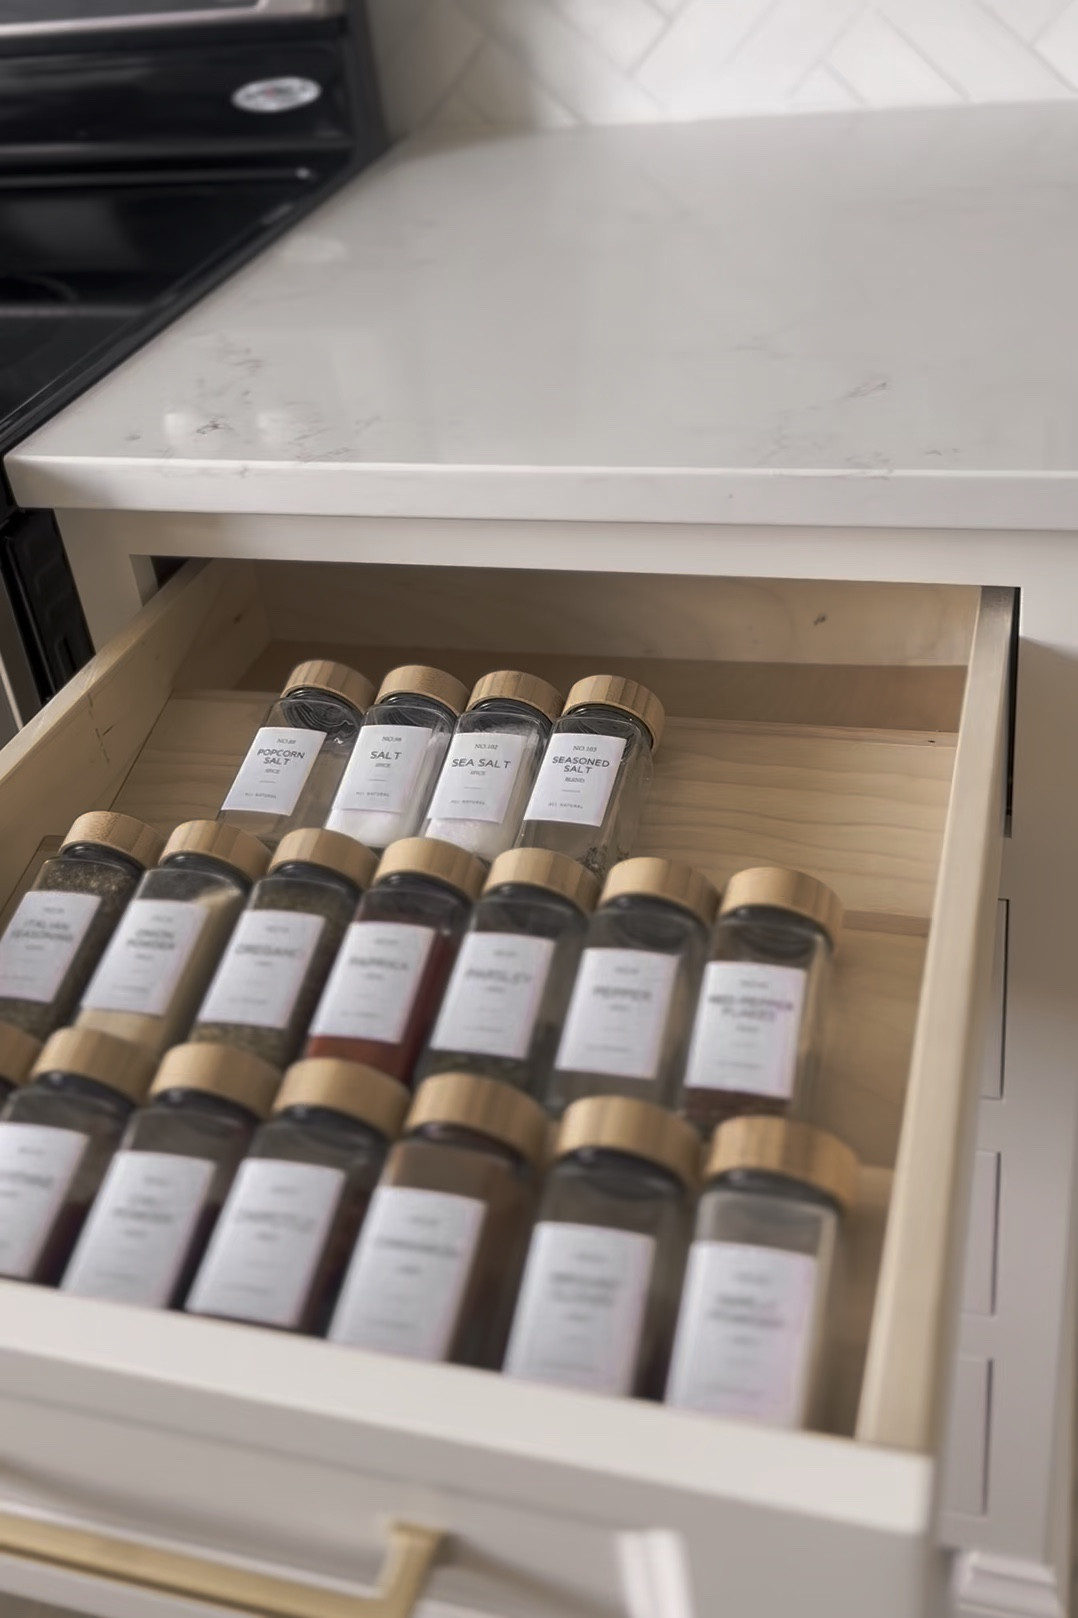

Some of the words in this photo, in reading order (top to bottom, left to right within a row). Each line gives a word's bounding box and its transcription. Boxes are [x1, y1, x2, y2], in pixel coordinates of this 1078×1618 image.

[257, 748, 305, 760] POPCORN
[369, 750, 402, 760] SALT
[263, 757, 291, 766] SALT
[451, 757, 475, 768] SEA
[478, 758, 511, 769] SALT
[551, 755, 610, 768] SEASONED
[563, 764, 593, 775] SALT
